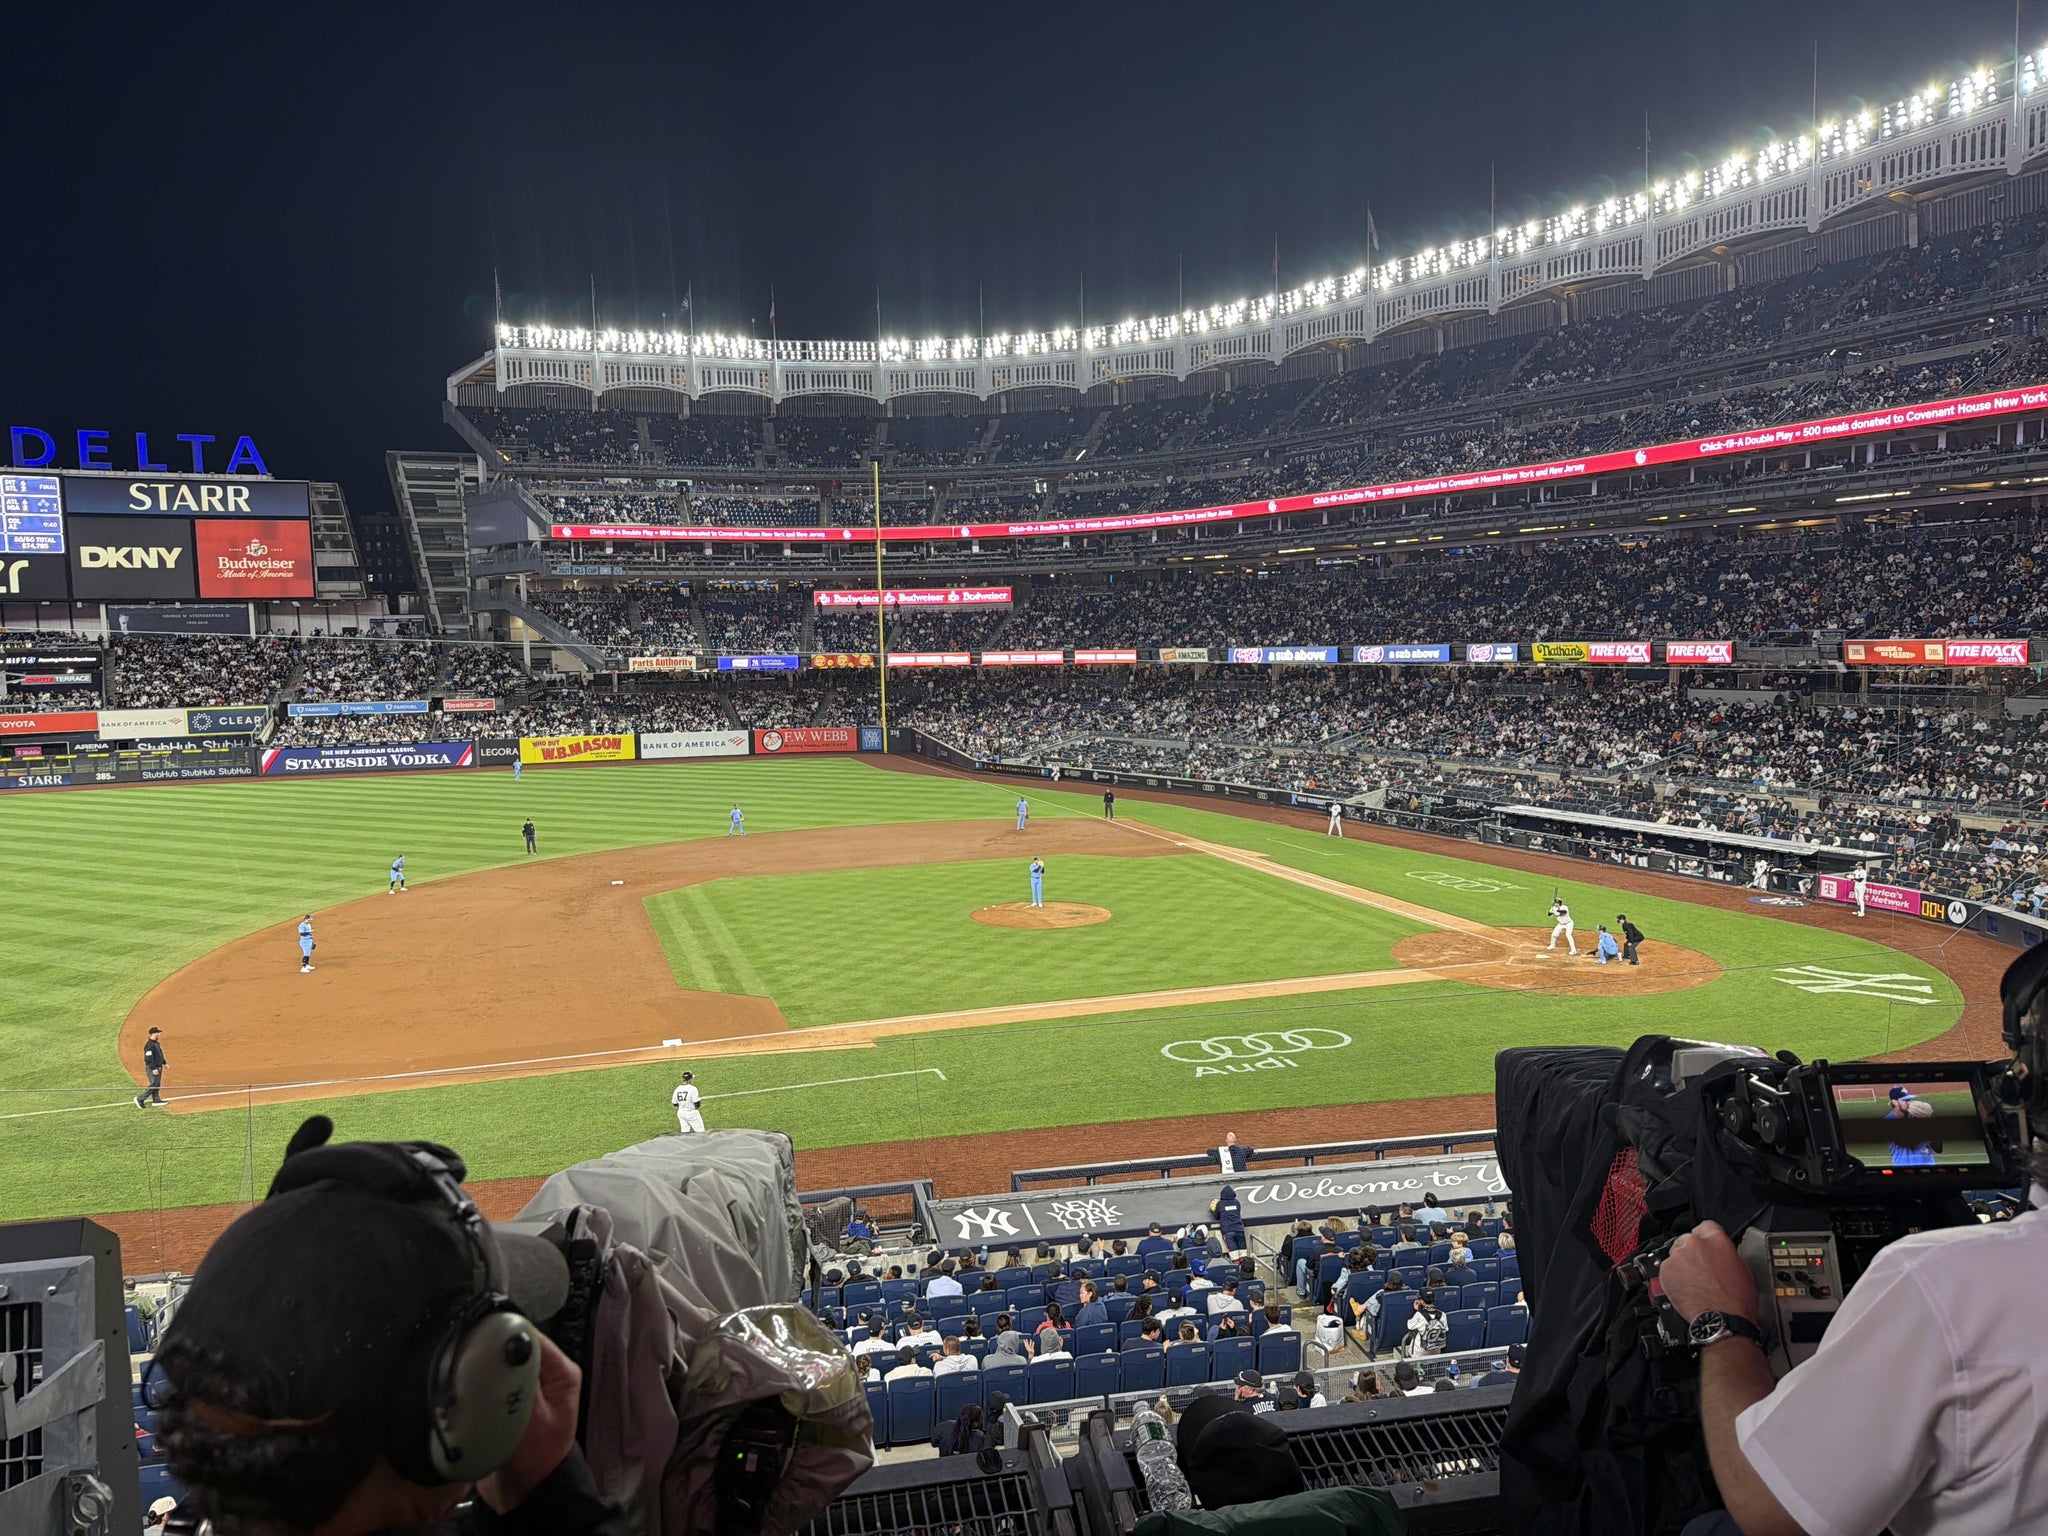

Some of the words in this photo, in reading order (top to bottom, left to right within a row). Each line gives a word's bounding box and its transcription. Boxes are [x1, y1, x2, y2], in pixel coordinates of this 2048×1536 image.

[1700, 438, 1744, 452] Chick-fil-A
[1744, 434, 1774, 446] Double
[1776, 431, 1793, 442] Play
[1803, 425, 1820, 436] 500
[1822, 422, 1849, 434] meals
[1850, 414, 1890, 429] donated
[1893, 414, 1904, 424] to
[1906, 406, 1955, 422] Covenant
[1958, 400, 1992, 414] House
[1994, 396, 2019, 408] New
[2021, 391, 2048, 404] York
[1402, 435, 1436, 447] ASPEN
[1450, 427, 1486, 440] VODKA
[10, 425, 269, 475] DELTA
[1344, 492, 1364, 501] Double
[1365, 490, 1376, 498] Play
[1382, 488, 1394, 496] 500
[1414, 482, 1439, 492] donated
[1449, 476, 1479, 488] Covenant
[1480, 475, 1501, 484] House
[1502, 472, 1518, 481] New
[1519, 470, 1534, 479] York
[1535, 468, 1548, 476] and
[1550, 466, 1564, 475] New
[1564, 463, 1585, 473] Jersey
[128, 482, 252, 512] STARR
[80, 546, 183, 569] DKNY
[217, 556, 295, 569] Budweiser
[217, 570, 246, 578] Made
[247, 571, 258, 579] of
[256, 569, 294, 578] America
[898, 593, 944, 602] Budweiser
[963, 592, 1008, 601] Budweiser
[1268, 651, 1275, 660] a
[1276, 649, 1294, 660] sub
[1294, 649, 1326, 660] above
[1389, 651, 1395, 659] a
[1396, 649, 1411, 659] sub
[1412, 649, 1440, 659] above
[1537, 644, 1584, 657] Nathan's
[1590, 645, 1615, 656] TIRE
[1616, 645, 1648, 660] RACK
[1668, 645, 1694, 656] TIRE
[1694, 645, 1729, 661] RACK
[1948, 645, 1980, 657] TIRE
[1980, 645, 2025, 662] RACK
[632, 659, 653, 667] Parts
[655, 658, 693, 668] Authority
[218, 715, 264, 725] CLEAR
[784, 731, 806, 742] F.W.
[810, 730, 848, 742] WEBB
[481, 748, 519, 756] LEGORA
[285, 756, 388, 771] STATESIDE
[392, 754, 451, 766] VODKA
[18, 774, 62, 786] STARR
[142, 770, 178, 779] StubHub
[181, 768, 215, 777] StubHub
[218, 767, 251, 775] StubHub
[1864, 886, 1903, 899] merica's
[1870, 895, 1910, 908] Network
[1921, 901, 1945, 919] 004
[1196, 1056, 1300, 1077] Audi
[677, 1091, 688, 1102] 67
[1235, 1178, 1423, 1204] Welcome
[1424, 1170, 1468, 1186] to
[1051, 1198, 1107, 1212] NEW
[1047, 1206, 1124, 1222] YORK
[952, 1207, 1020, 1240] NY
[1060, 1216, 1120, 1230] LIFE
[1253, 1401, 1276, 1415] JUDGE
